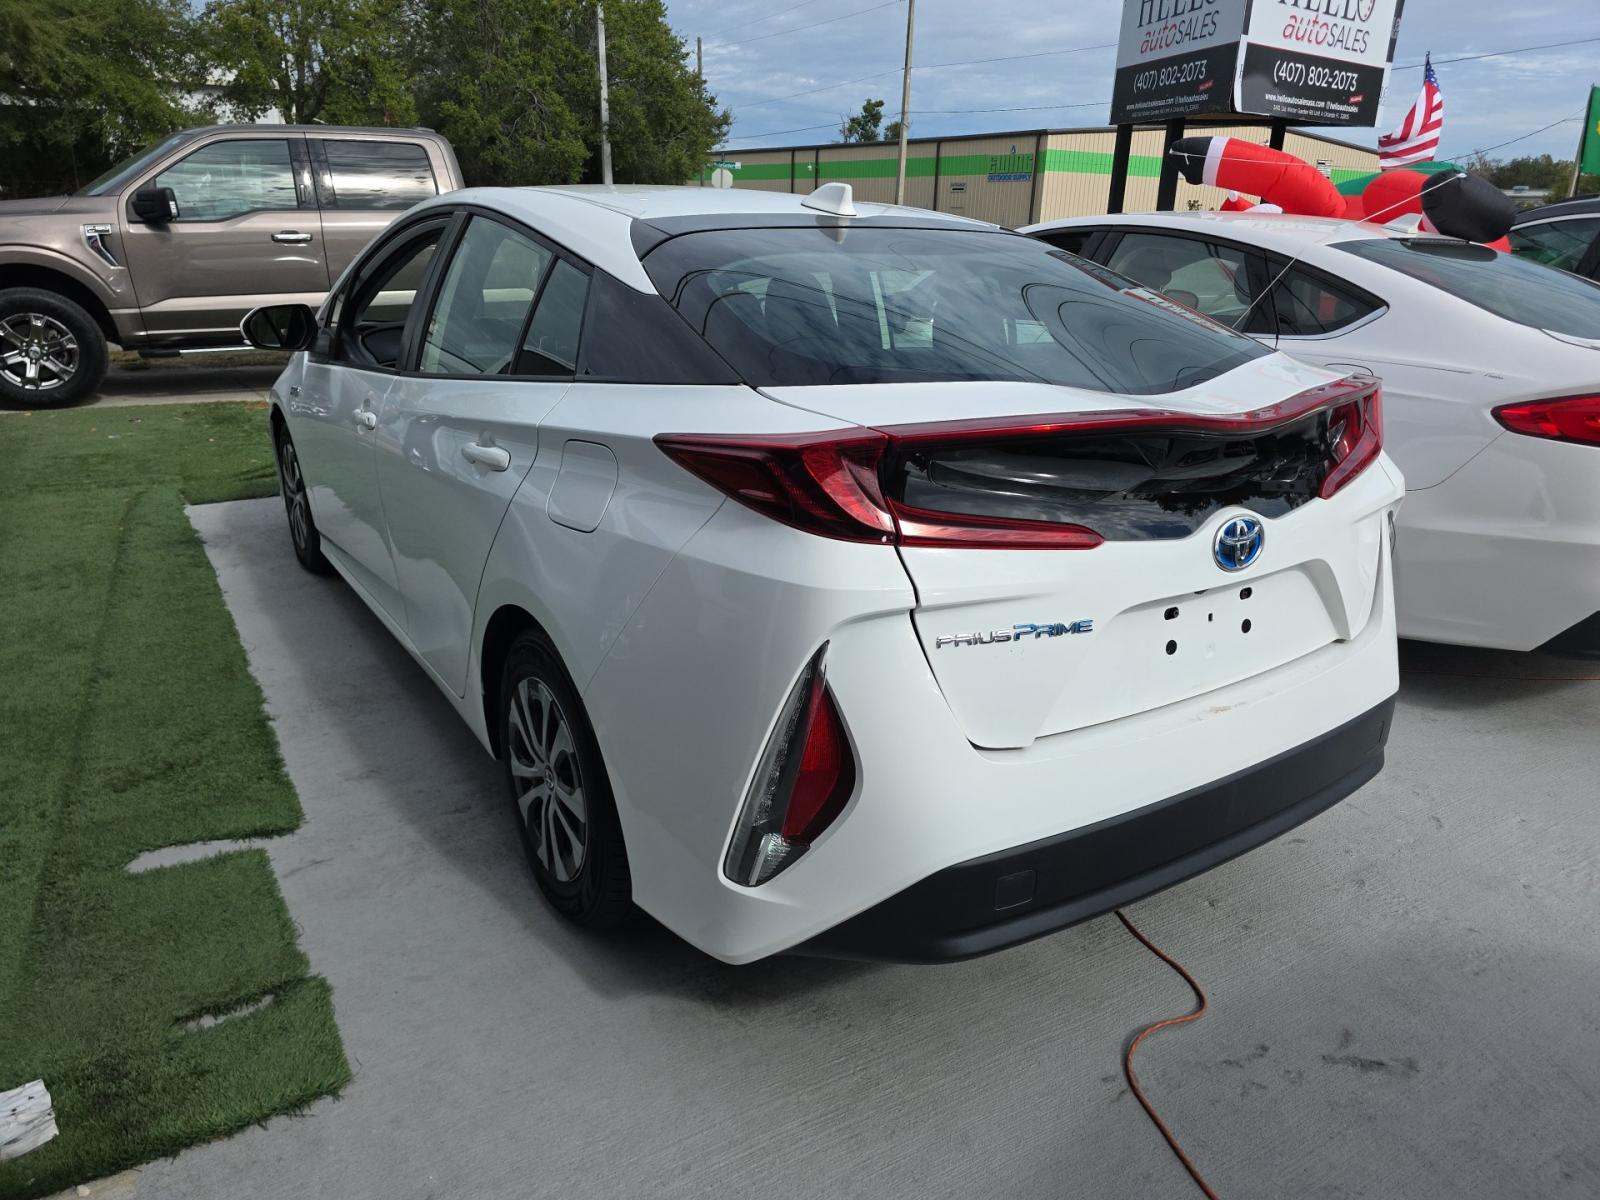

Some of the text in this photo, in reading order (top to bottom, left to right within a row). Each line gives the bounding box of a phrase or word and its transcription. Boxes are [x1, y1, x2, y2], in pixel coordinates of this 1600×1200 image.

[1133, 60, 1208, 94] (407) 802-2073
[1273, 60, 1359, 92] (407) 802-2073
[935, 618, 1094, 649] PRIUS PRIME
